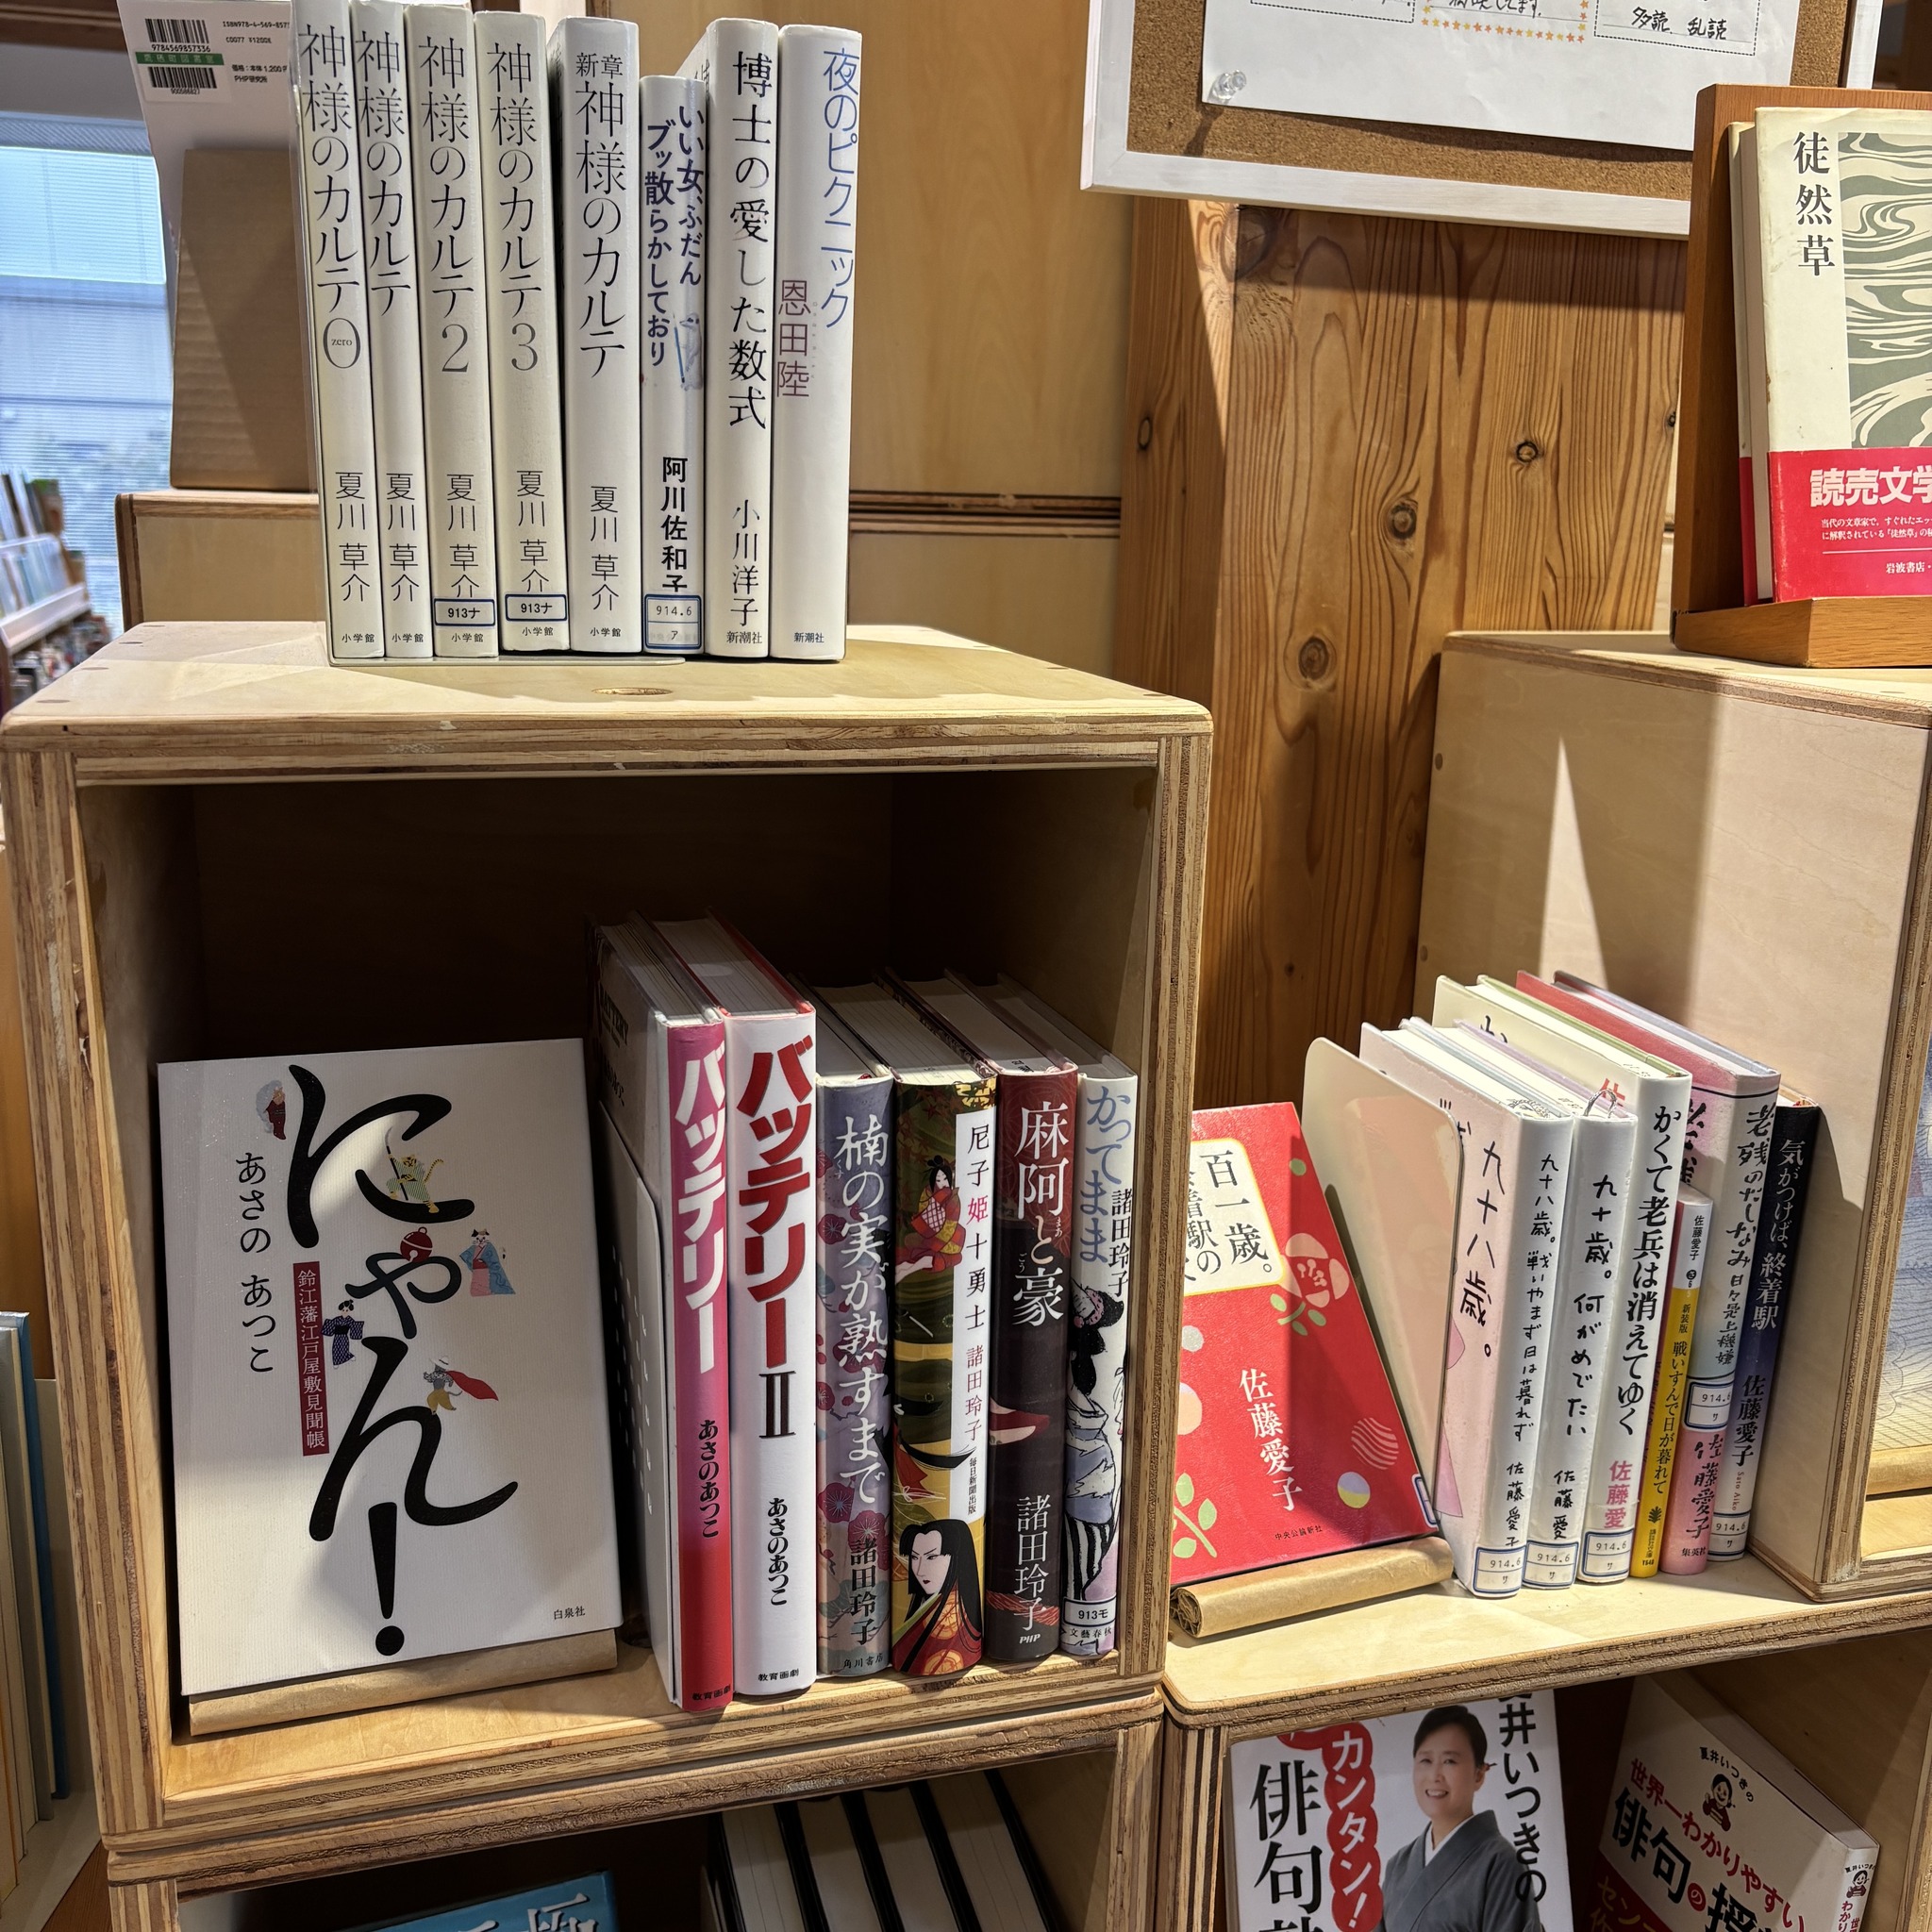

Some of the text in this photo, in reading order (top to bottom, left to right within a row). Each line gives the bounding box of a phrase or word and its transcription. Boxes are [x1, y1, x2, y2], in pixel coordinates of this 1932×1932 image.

[575, 52, 624, 79] 新章
[355, 30, 411, 316] 神様のカルテ
[676, 106, 705, 286] いい女、ふだん
[821, 47, 860, 328] 夜のピクニック
[1793, 131, 1835, 276] 徒然草
[575, 81, 627, 377] 神様のカルテ
[644, 120, 675, 367] ブッ散らかしており
[728, 51, 773, 429] 博士の愛した数式
[776, 280, 811, 397] 恩田陸
[660, 457, 689, 592] 阿川佐和子
[730, 500, 759, 627] 小川洋子
[341, 633, 375, 643] 小学館
[391, 633, 425, 643] 小学館
[446, 606, 480, 620] 913ナ
[451, 632, 484, 643] 小学館
[520, 601, 552, 614] 913ナ
[522, 625, 554, 637] 小学館
[590, 627, 621, 638] 小学館
[656, 605, 692, 616] 914.6
[725, 631, 762, 644] 新潮社
[793, 632, 824, 643] 新潮社
[675, 1041, 725, 1374] バッテリー
[965, 1124, 989, 1330] 尼子姫十勇士
[1012, 1102, 1068, 1326] 麻阿と豪
[1079, 1087, 1131, 1263] かってまま
[1199, 1150, 1272, 1273] 百一歳。
[1726, 1103, 1775, 1268] 老残のたしなみ
[1108, 1189, 1132, 1297] 諸田玲子
[1618, 1107, 1681, 1436] かくて老兵は消えてゆく
[1751, 1139, 1806, 1330] 気がつけば、終着駅
[297, 1269, 325, 1448] 鈴江藩江戸屋敷見聞帳
[834, 1115, 888, 1504] 楠の実が熟すまで
[1679, 1304, 1690, 1333] 新装版
[965, 1346, 985, 1441] 諸田玲子
[1239, 1368, 1303, 1511] 佐藤愛子
[1653, 1341, 1687, 1494] 戦いすんで日が暮れて
[1732, 1374, 1767, 1466] 佐藤愛子
[698, 1420, 719, 1537] あさのあつこ
[968, 1457, 977, 1514] 毎日新聞出版
[1506, 1462, 1524, 1546] 佐藤愛子
[1686, 1434, 1724, 1539] 佐藤愛子
[768, 1498, 789, 1606] あさのあつこ
[1014, 1495, 1051, 1631] 諸田玲子
[1274, 1524, 1323, 1541] 中央公論新社
[1491, 1557, 1521, 1568] 914.6
[1537, 1553, 1570, 1563] 914.6
[1596, 1541, 1626, 1551] 914.6
[553, 1606, 585, 1621] 白泉社
[850, 1538, 877, 1644] 諸田玲子
[1019, 1634, 1041, 1643] PHP
[1078, 1608, 1108, 1620] 913モ
[758, 1668, 799, 1681] 教育画劇
[843, 1653, 883, 1668] 角川書店
[1498, 1691, 1547, 1903] 井いつきの
[1699, 1746, 1755, 1803] 夏井いつきの
[1249, 1759, 1324, 1932] 俳句
